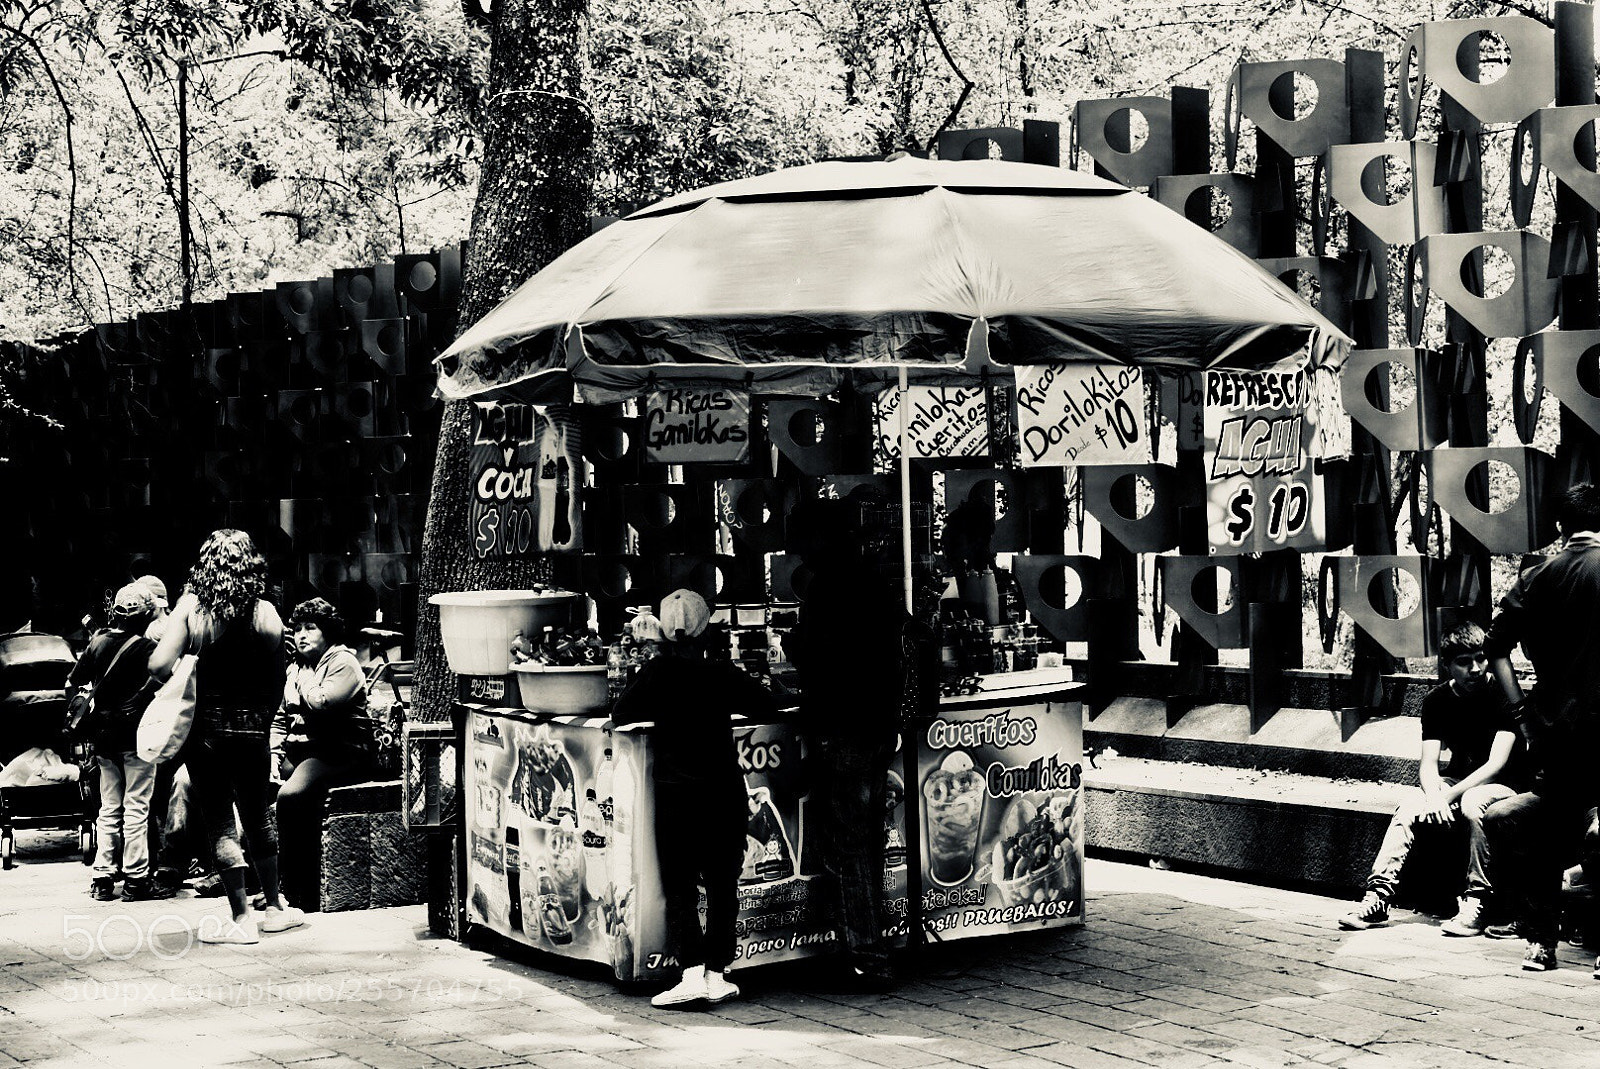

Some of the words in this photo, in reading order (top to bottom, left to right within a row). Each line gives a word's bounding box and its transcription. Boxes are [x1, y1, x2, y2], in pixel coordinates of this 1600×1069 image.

[477, 467, 533, 500] COCA
[927, 709, 1038, 750] Cueritos
[747, 938, 786, 959] pero
